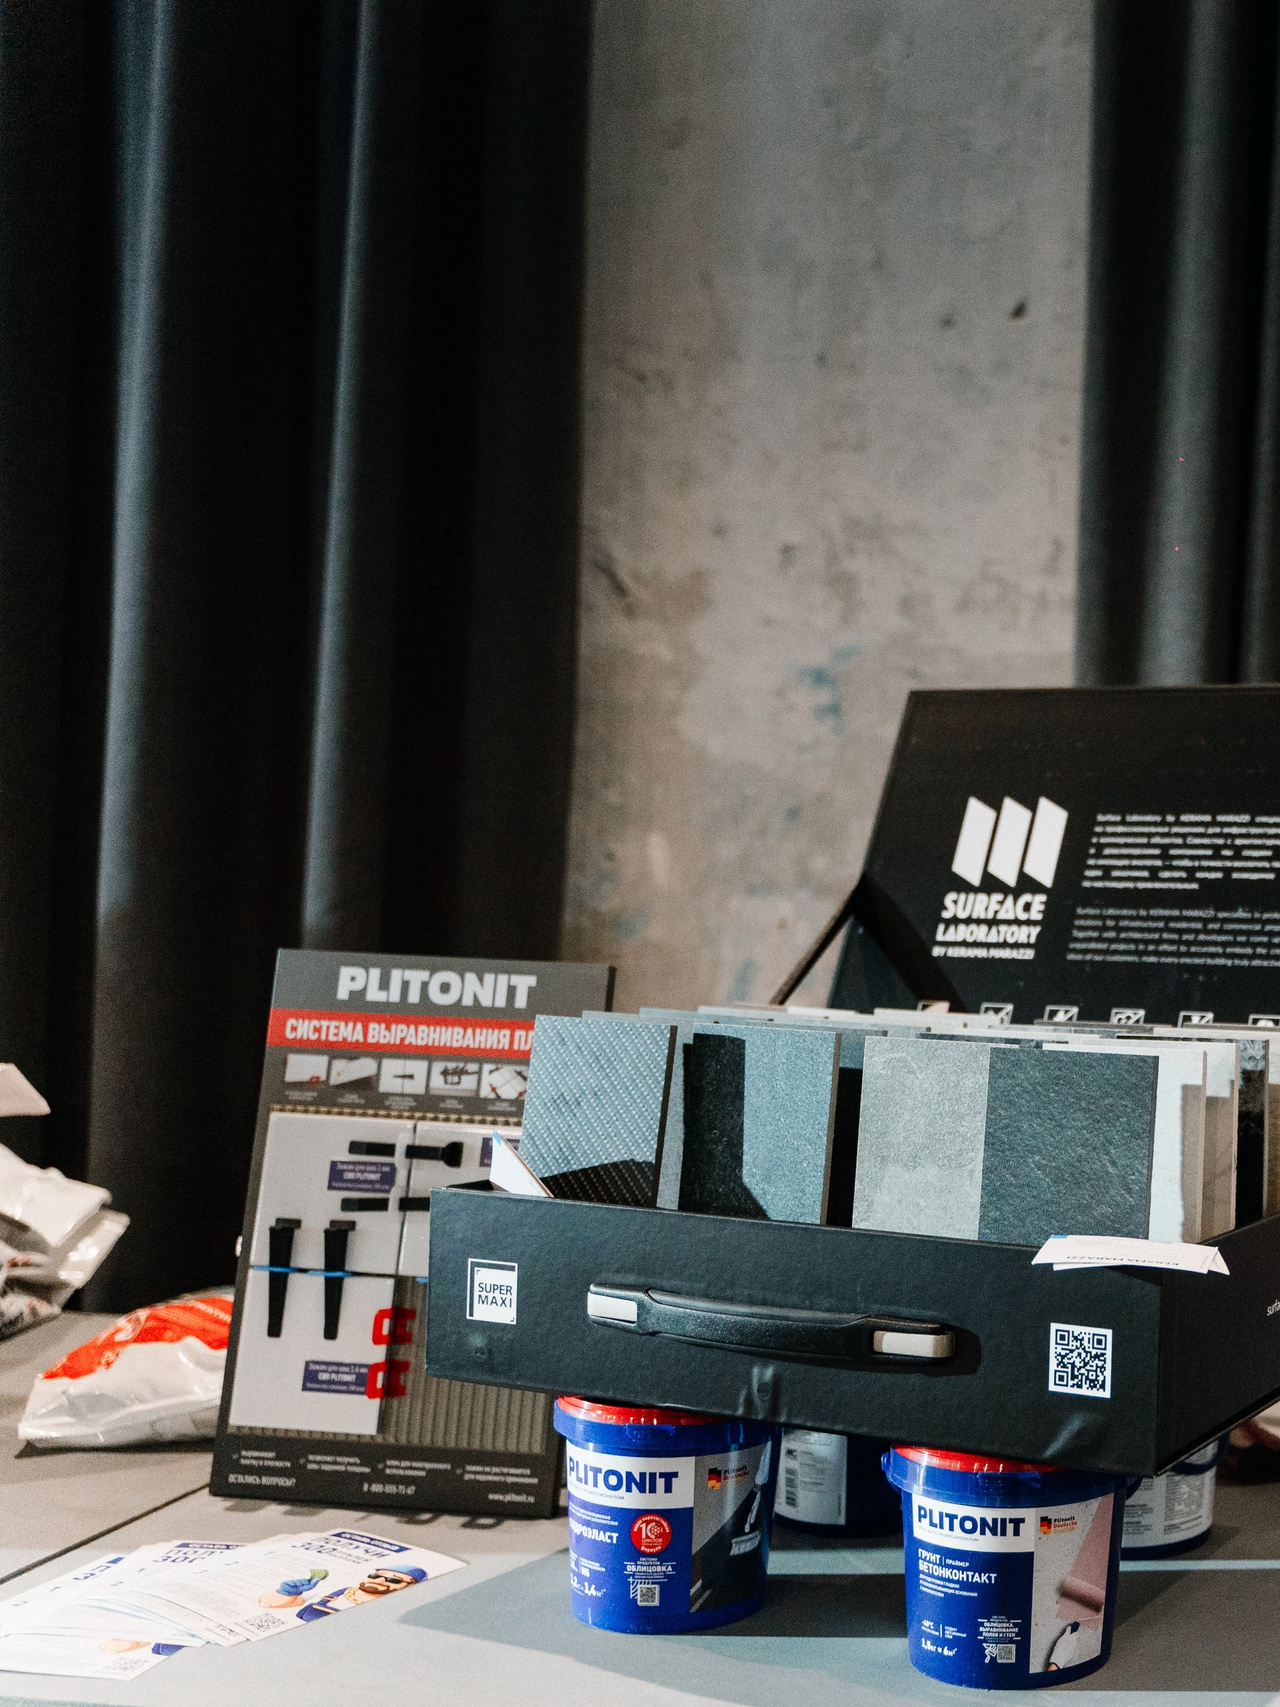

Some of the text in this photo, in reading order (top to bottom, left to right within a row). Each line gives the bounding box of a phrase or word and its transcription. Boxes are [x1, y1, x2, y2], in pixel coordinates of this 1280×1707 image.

[941, 890, 1048, 921] SURFACE
[935, 921, 1042, 944] LABORATORY
[336, 965, 538, 1009] PLITONIT
[285, 1018, 364, 1043] СИСТЕМА
[367, 1022, 510, 1051] ВЫРАВНИВАНИЯ
[477, 1294, 513, 1308] MAXI
[478, 1282, 513, 1296] SUPER
[568, 1455, 679, 1495] PLITONIT
[917, 1504, 1026, 1537] PLITONIT
[1053, 1515, 1075, 1523] Plitonit
[626, 1564, 673, 1573] ОБЛИЦОВКА
[918, 1547, 970, 1568] ГРУНТ ПРАЙМЕР
[918, 1559, 997, 1584] БЕТОНКОНТАКТ
